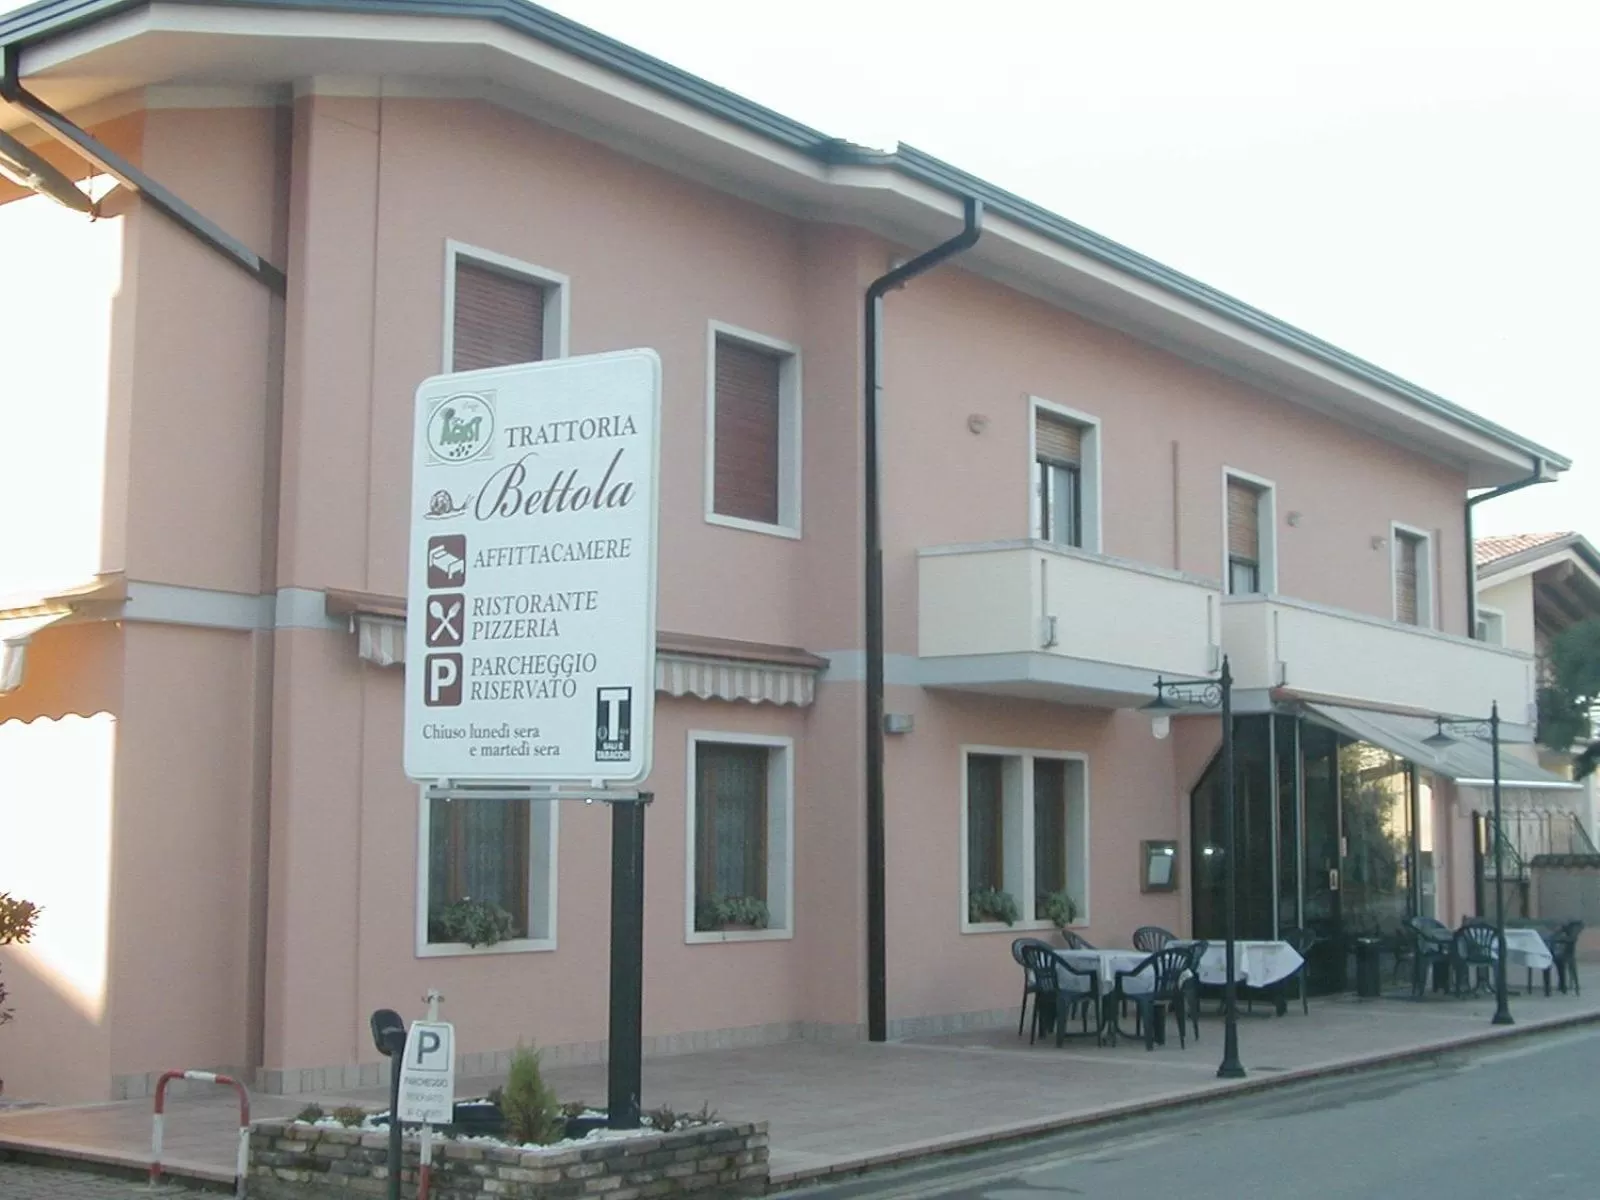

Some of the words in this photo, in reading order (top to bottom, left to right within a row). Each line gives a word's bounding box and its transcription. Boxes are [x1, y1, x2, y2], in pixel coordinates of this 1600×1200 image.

[504, 415, 637, 448] TRATTORIA
[474, 447, 636, 521] Bettola
[473, 538, 632, 568] AFFITTACAMERE
[471, 590, 599, 617] RISTORANTE
[471, 618, 560, 641] PIZZERIA
[470, 653, 597, 677] PARCHEGGIO
[429, 658, 458, 703] P
[470, 679, 577, 701] RISERVATO
[599, 689, 629, 741] T
[422, 723, 466, 739] Chiuso
[513, 726, 540, 739] sera
[469, 747, 477, 757] e
[533, 744, 560, 757] sera
[416, 1030, 441, 1065] P
